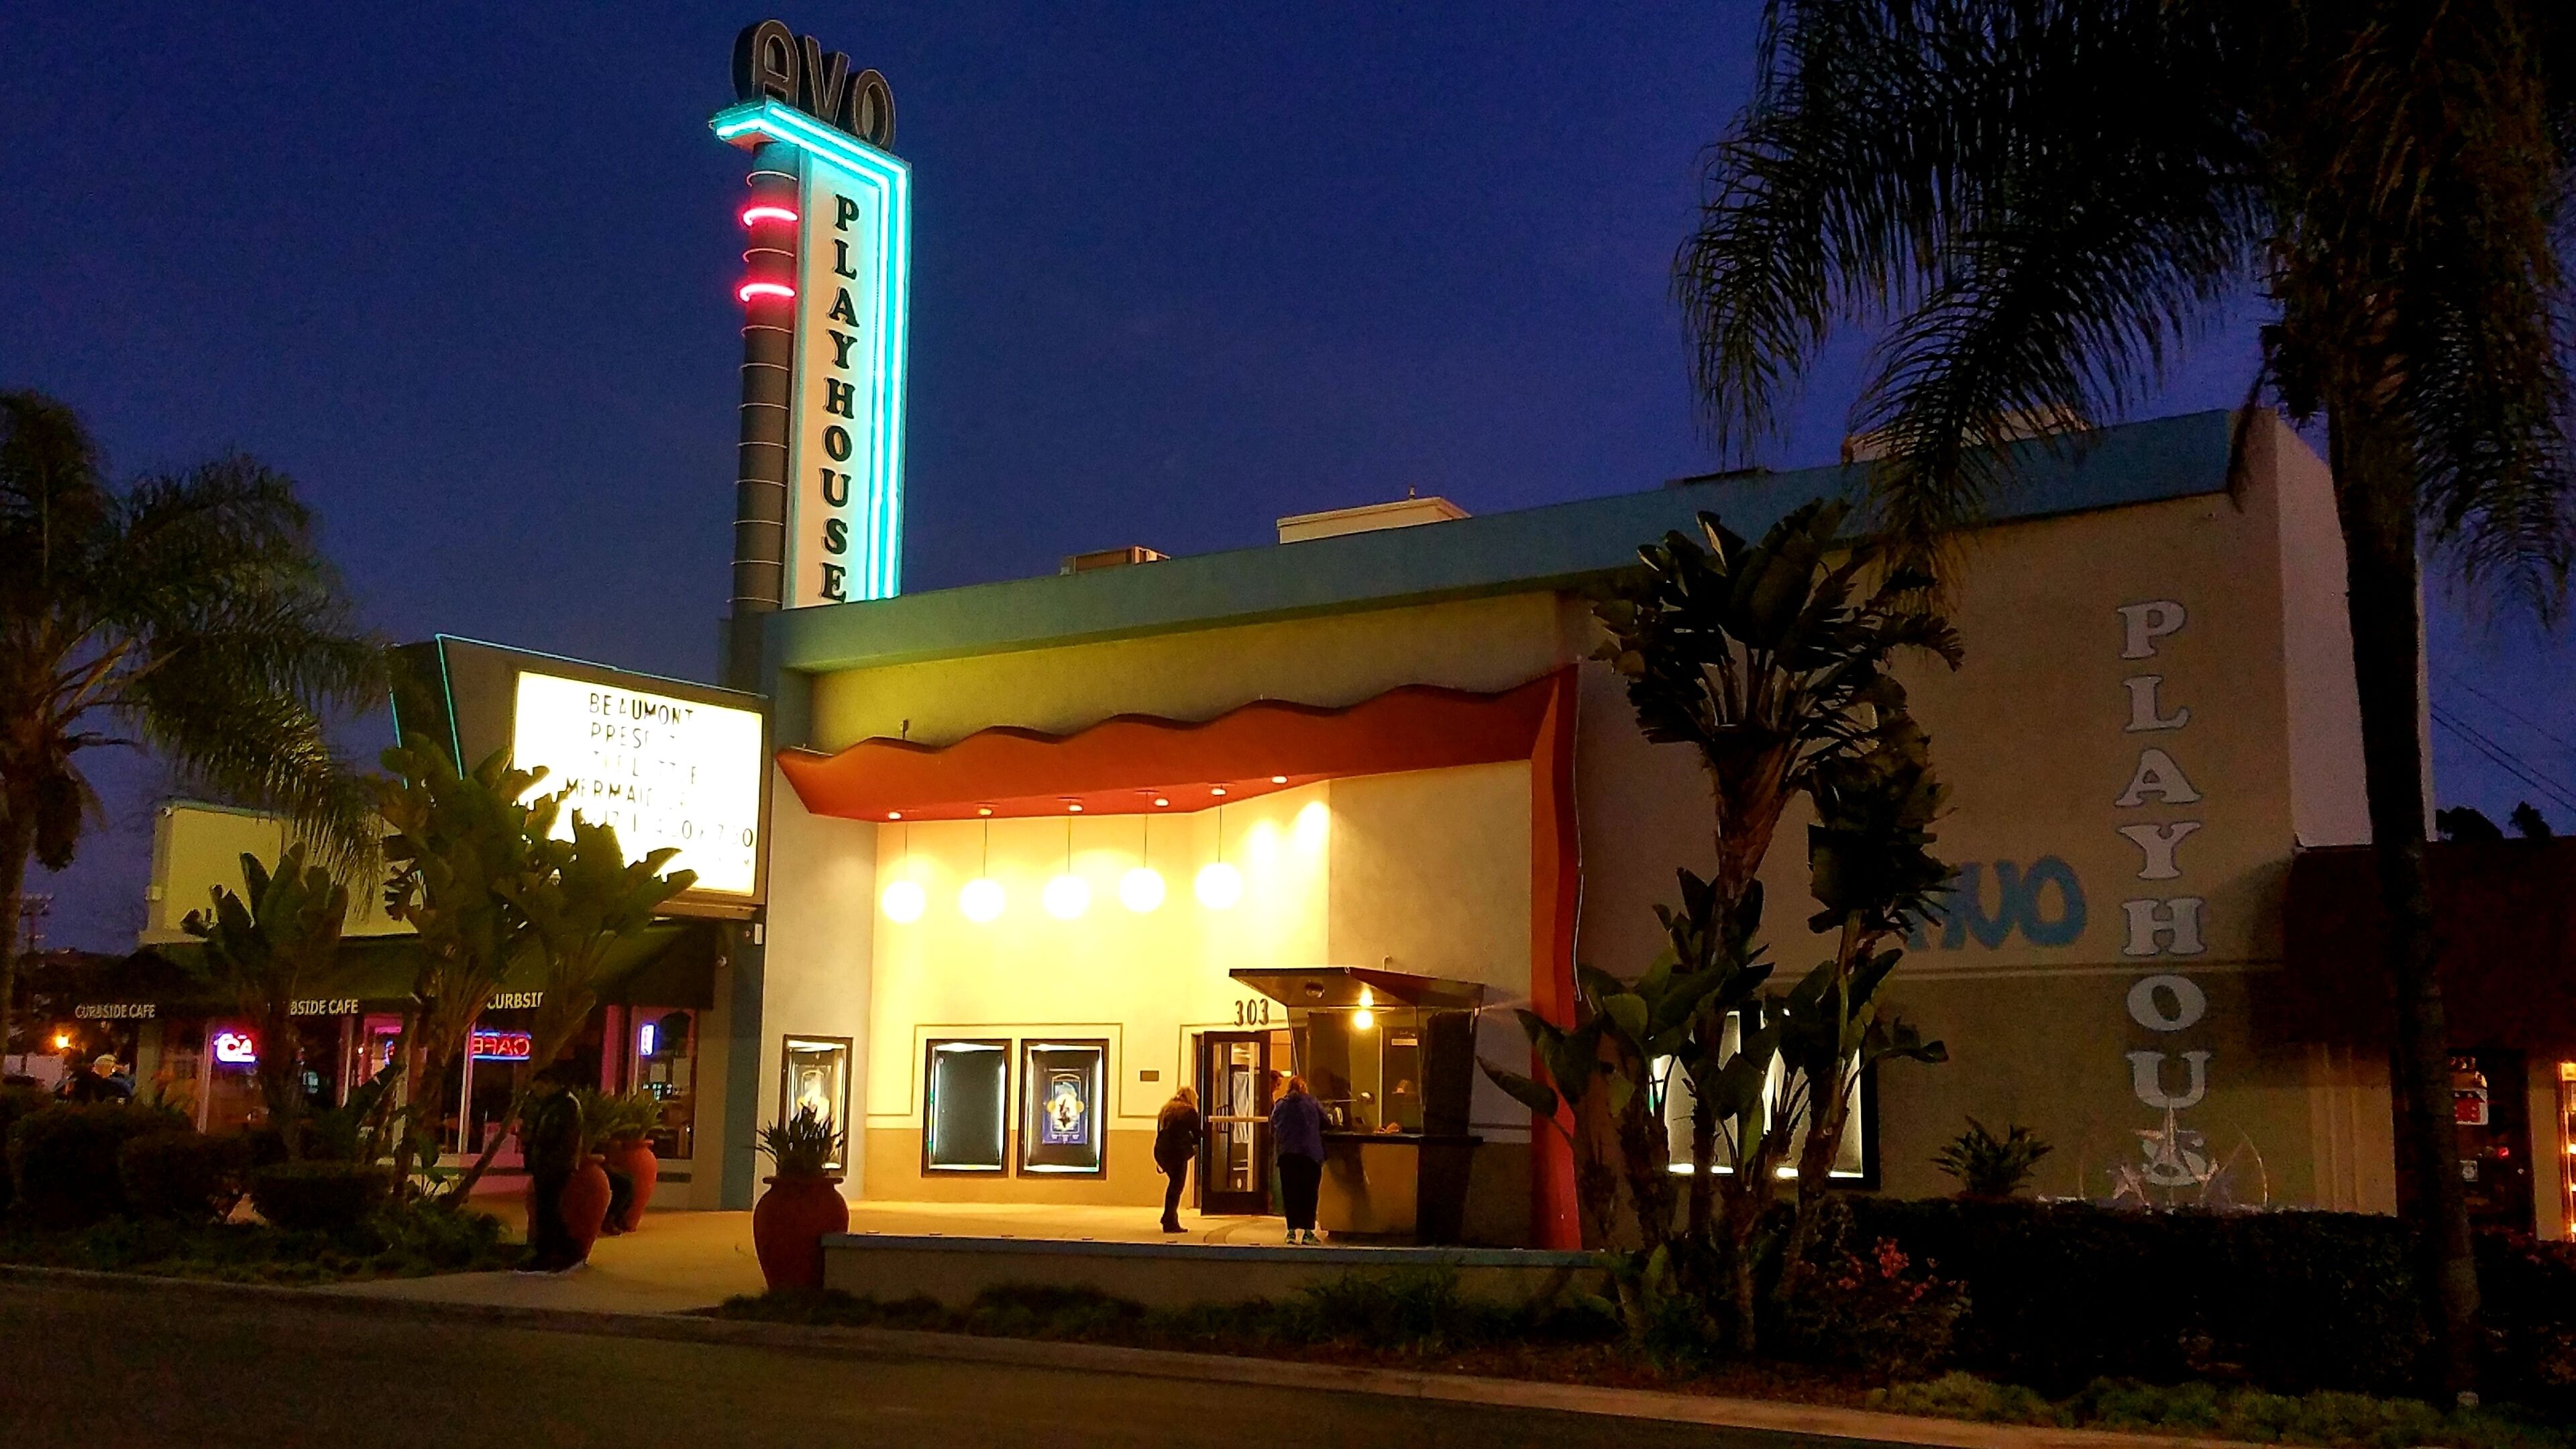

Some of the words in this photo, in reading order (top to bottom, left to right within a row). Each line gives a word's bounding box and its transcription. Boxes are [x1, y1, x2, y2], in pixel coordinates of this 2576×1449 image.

[735, 19, 896, 151] AVO
[820, 194, 859, 604] PLAYHOUSE
[590, 692, 694, 725] BEAUMONT
[129, 1003, 156, 1018] CAFE
[328, 998, 359, 1015] CAFE
[1234, 998, 1269, 1027] 303
